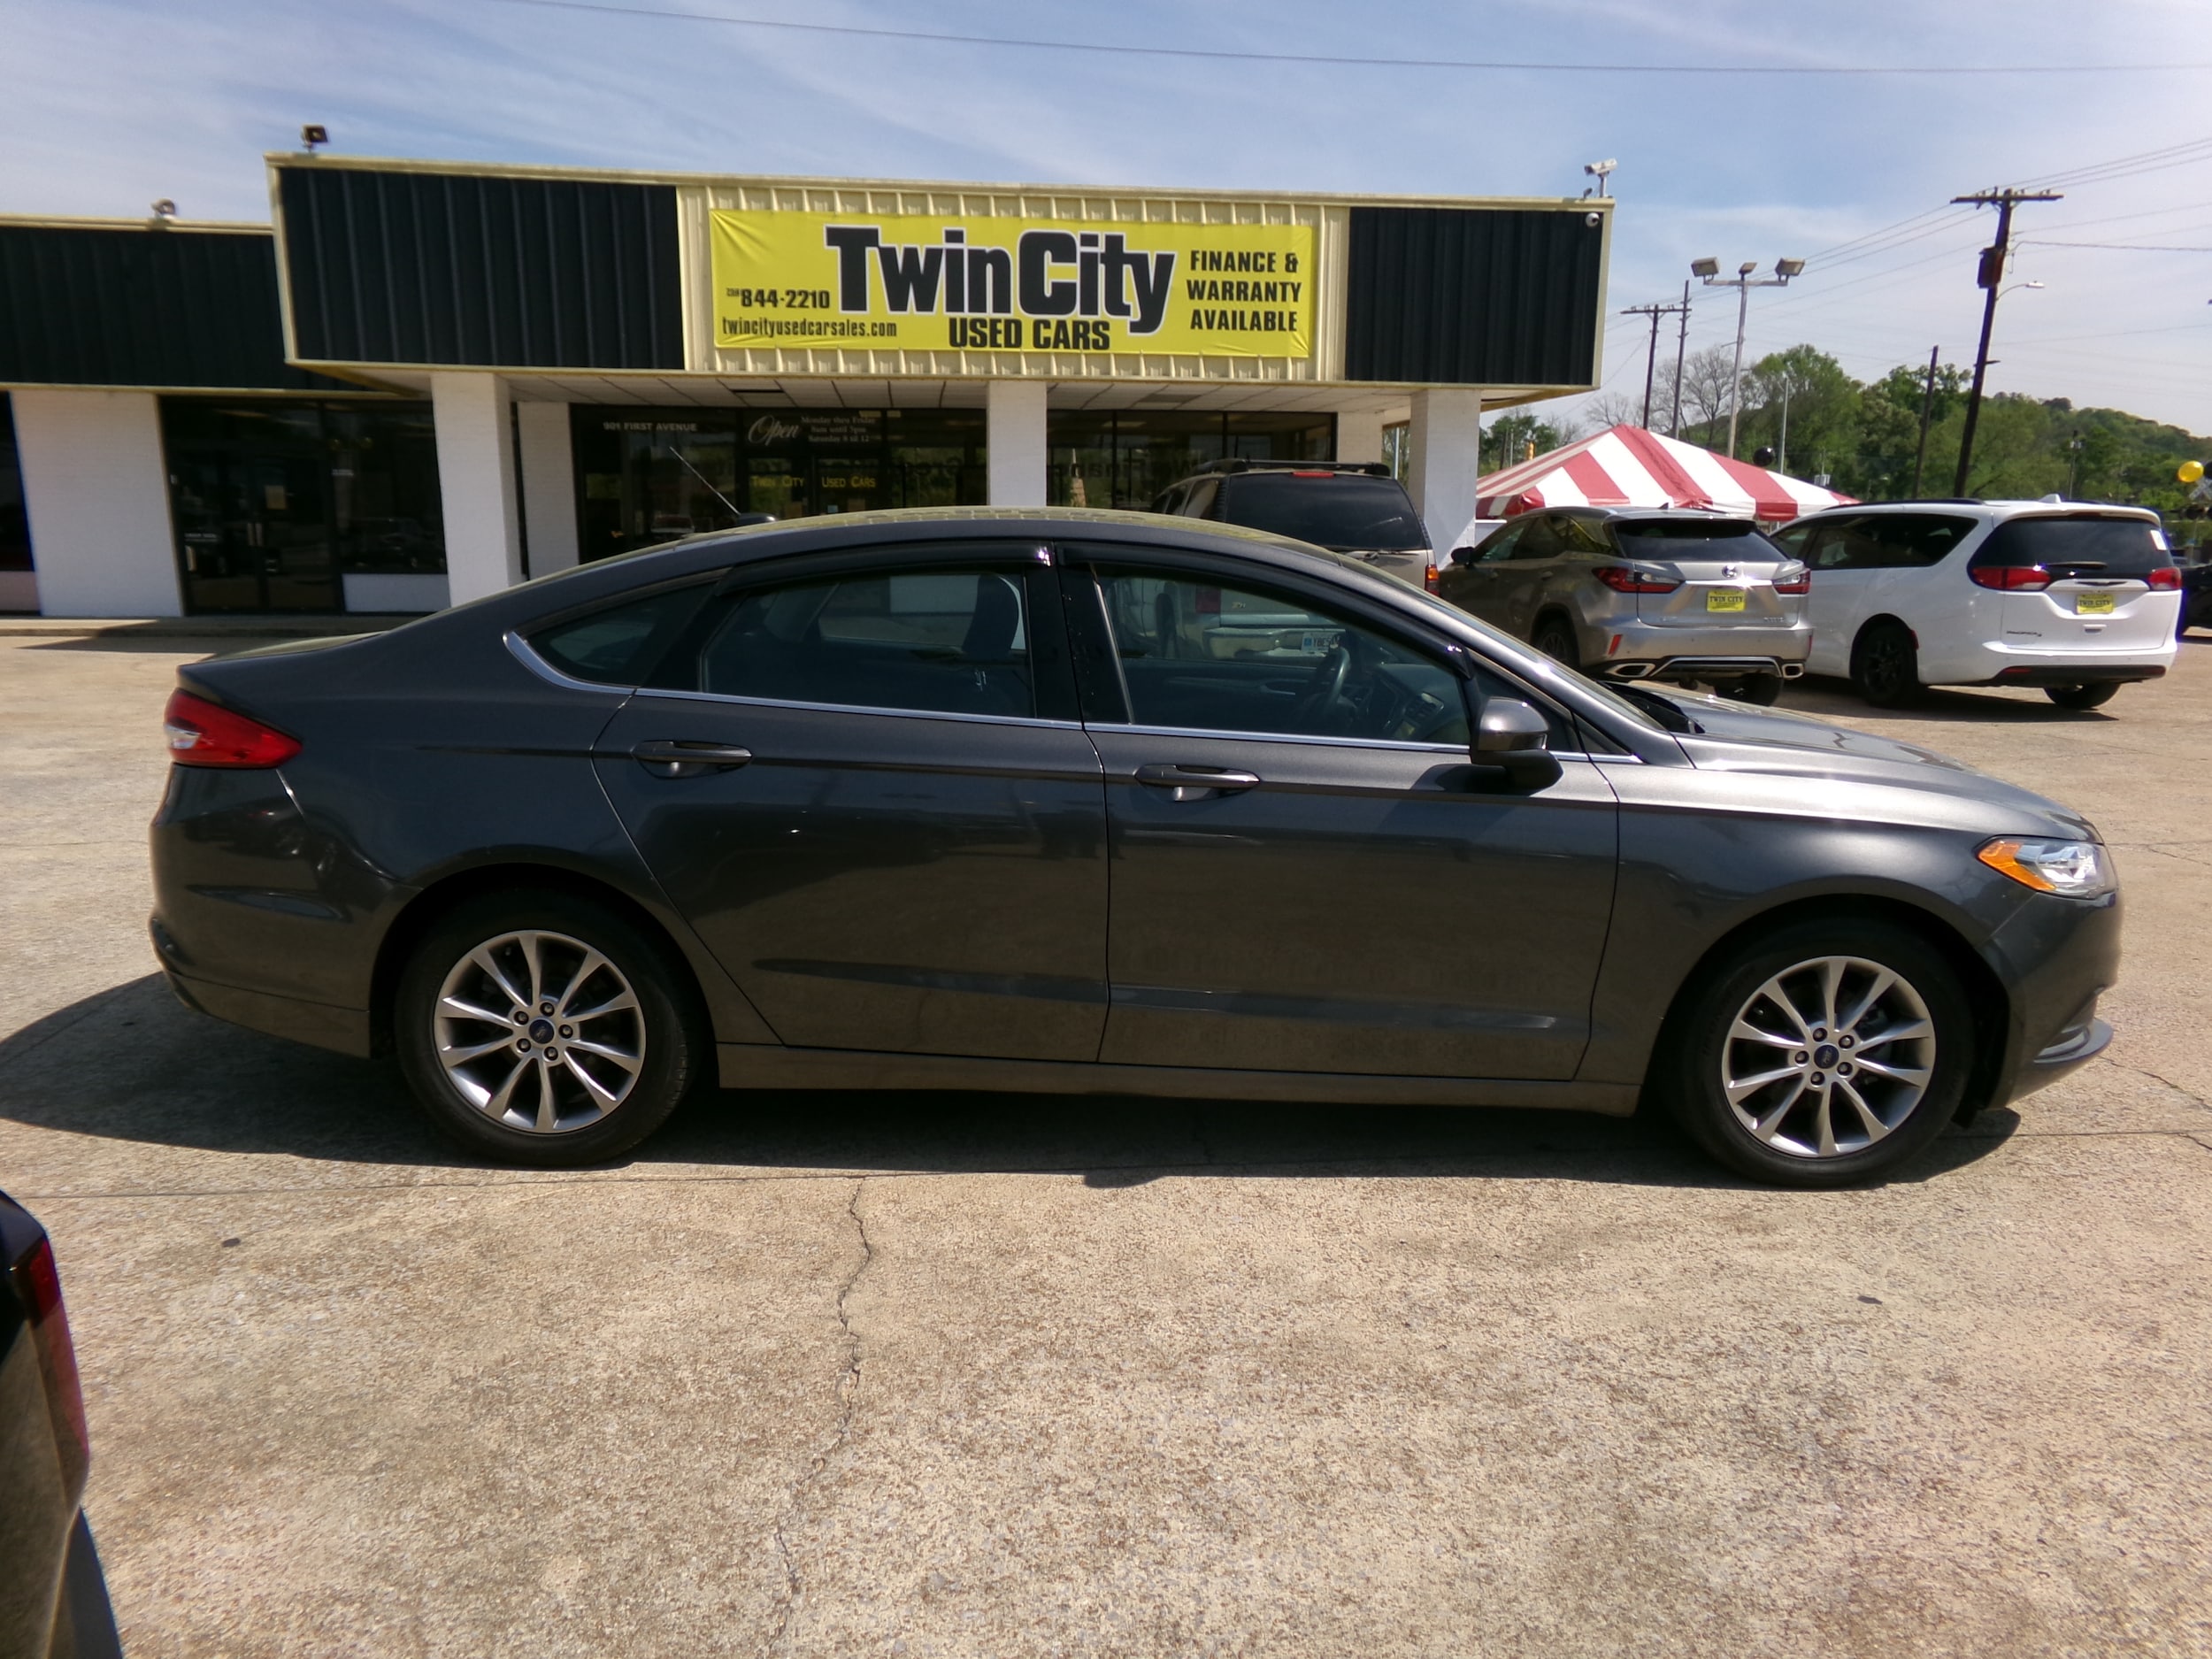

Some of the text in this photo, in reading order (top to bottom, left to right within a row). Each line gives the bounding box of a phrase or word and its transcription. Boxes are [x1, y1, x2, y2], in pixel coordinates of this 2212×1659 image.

[1190, 250, 1299, 273] FINANCE &
[741, 288, 831, 309] 844-2210
[1186, 279, 1302, 303] WARRANTY
[722, 316, 898, 338] twincityusedcarsales.com
[1189, 309, 1298, 332] AVAILABLE
[949, 317, 1110, 350] USED CARS
[623, 422, 653, 431] FIRST
[656, 422, 697, 432] AVENUE
[748, 415, 800, 446] Open
